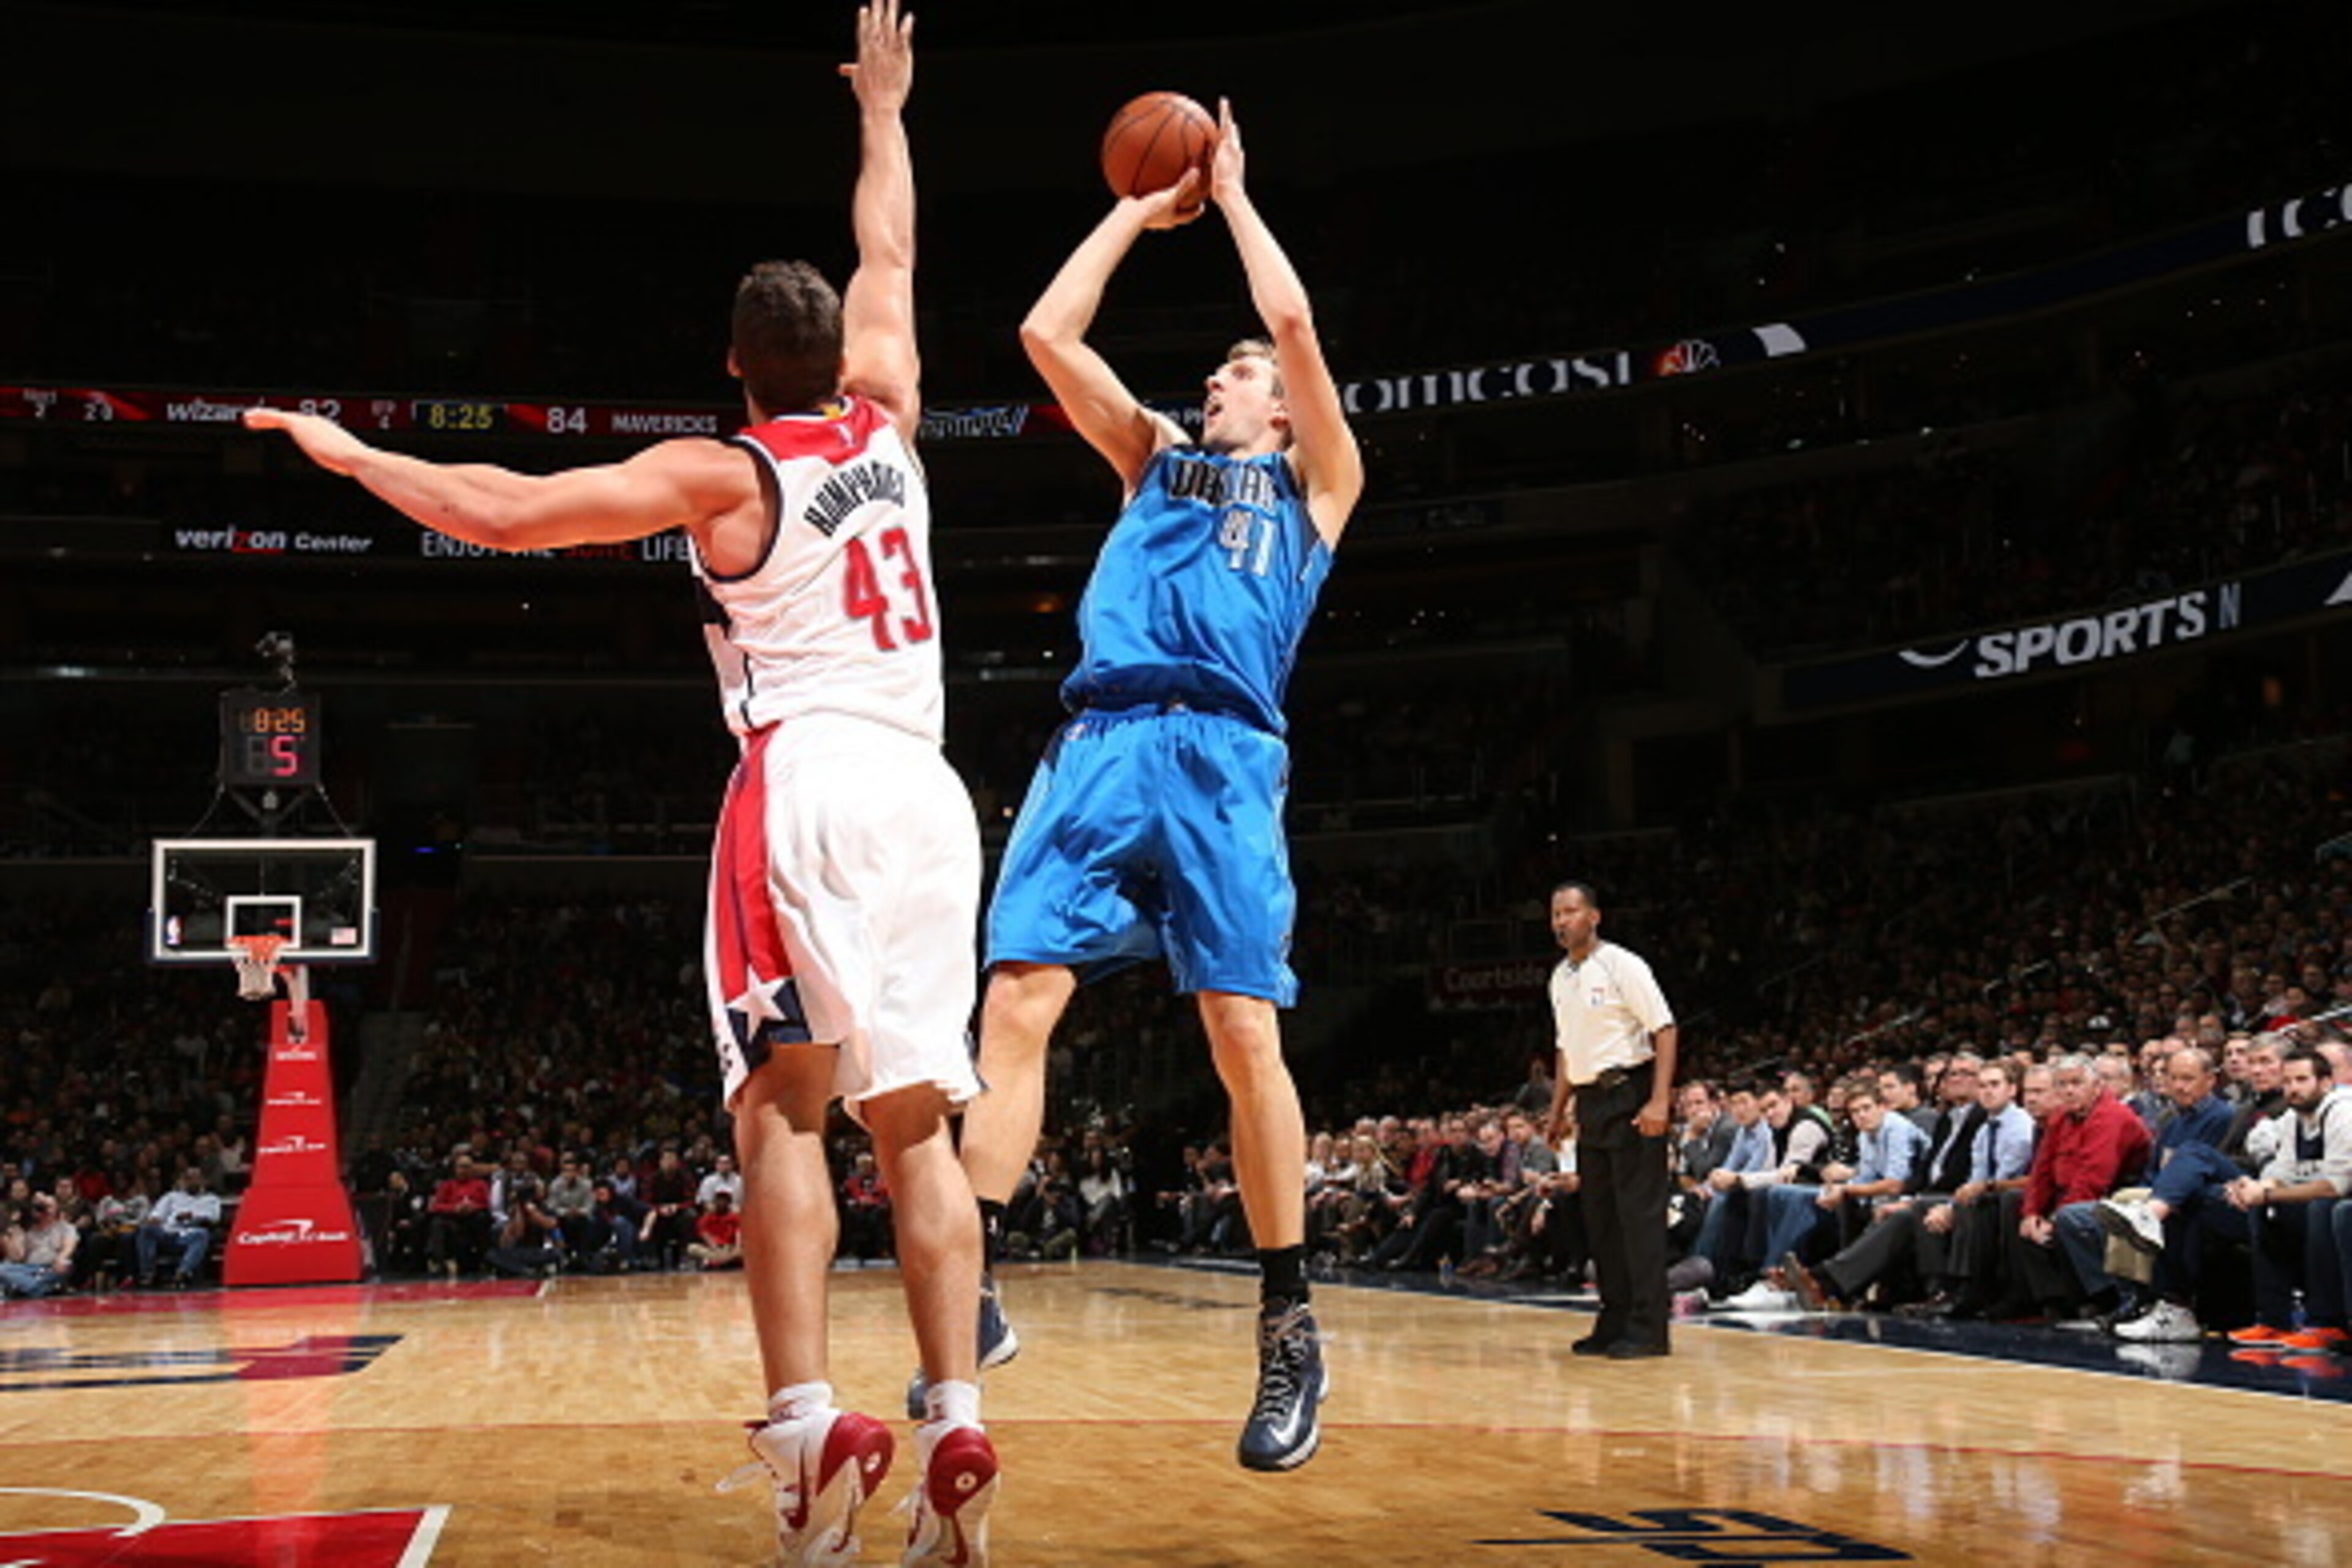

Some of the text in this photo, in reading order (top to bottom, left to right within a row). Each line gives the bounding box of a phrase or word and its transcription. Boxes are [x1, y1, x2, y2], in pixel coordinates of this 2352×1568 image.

[430, 403, 492, 429] 8:25
[546, 407, 587, 433] 84
[611, 412, 717, 434] MAVERICKS
[175, 524, 372, 552] verizon Center
[642, 536, 688, 562] LIFE
[1219, 509, 1275, 578] 41
[843, 526, 933, 652] 43
[1973, 582, 2241, 679] SPORTS N
[271, 734, 298, 777] 5
